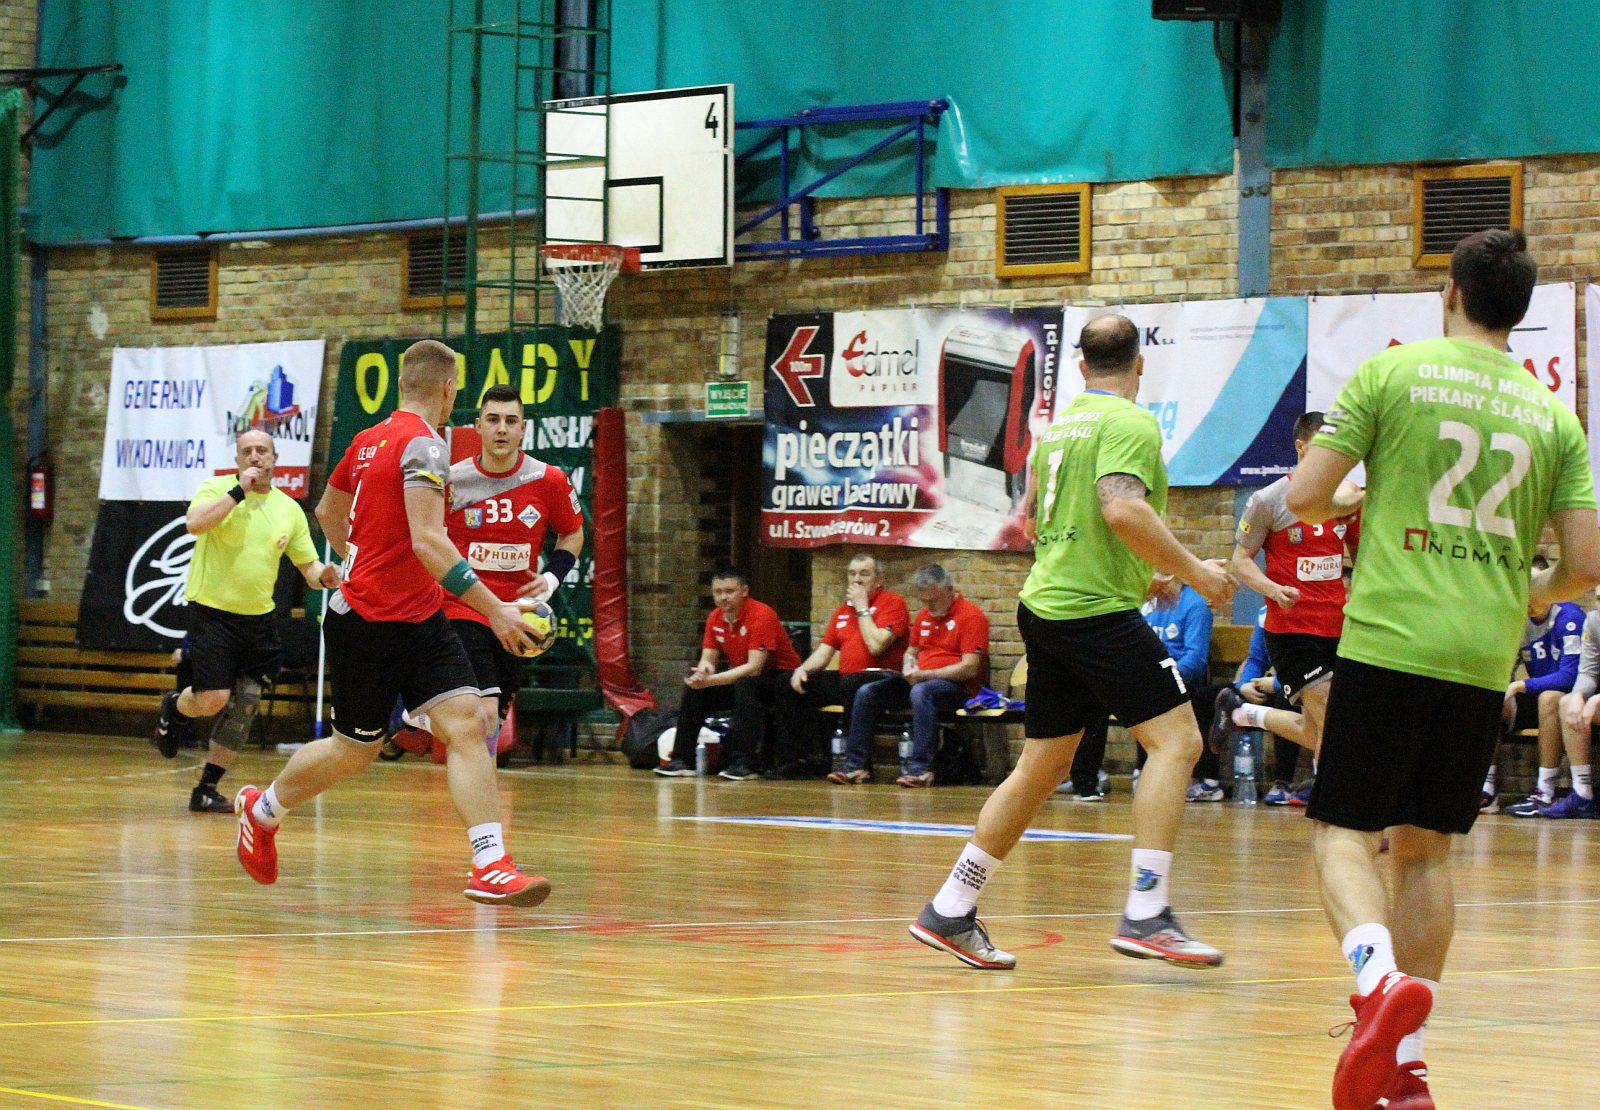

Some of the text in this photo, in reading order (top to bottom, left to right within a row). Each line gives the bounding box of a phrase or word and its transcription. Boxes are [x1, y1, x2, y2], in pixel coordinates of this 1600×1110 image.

[704, 102, 719, 138] 4
[355, 339, 596, 415] OADY
[1038, 323, 1058, 417] l.com.pl
[1417, 364, 1493, 391] OLIMPIA
[123, 379, 207, 410] GENERALNY
[859, 382, 919, 392] PAPIER
[1410, 386, 1554, 433] PIEKARY ŚLĄSKIE
[116, 439, 206, 469] WYKONAWCA
[774, 416, 919, 481] pieczątki
[270, 473, 305, 491] ol.pl
[1428, 420, 1532, 538] 22
[485, 498, 514, 524] 33
[771, 484, 841, 511] grawer
[879, 519, 890, 537] 2
[492, 551, 529, 561] HURAS
[965, 858, 987, 874] MKS
